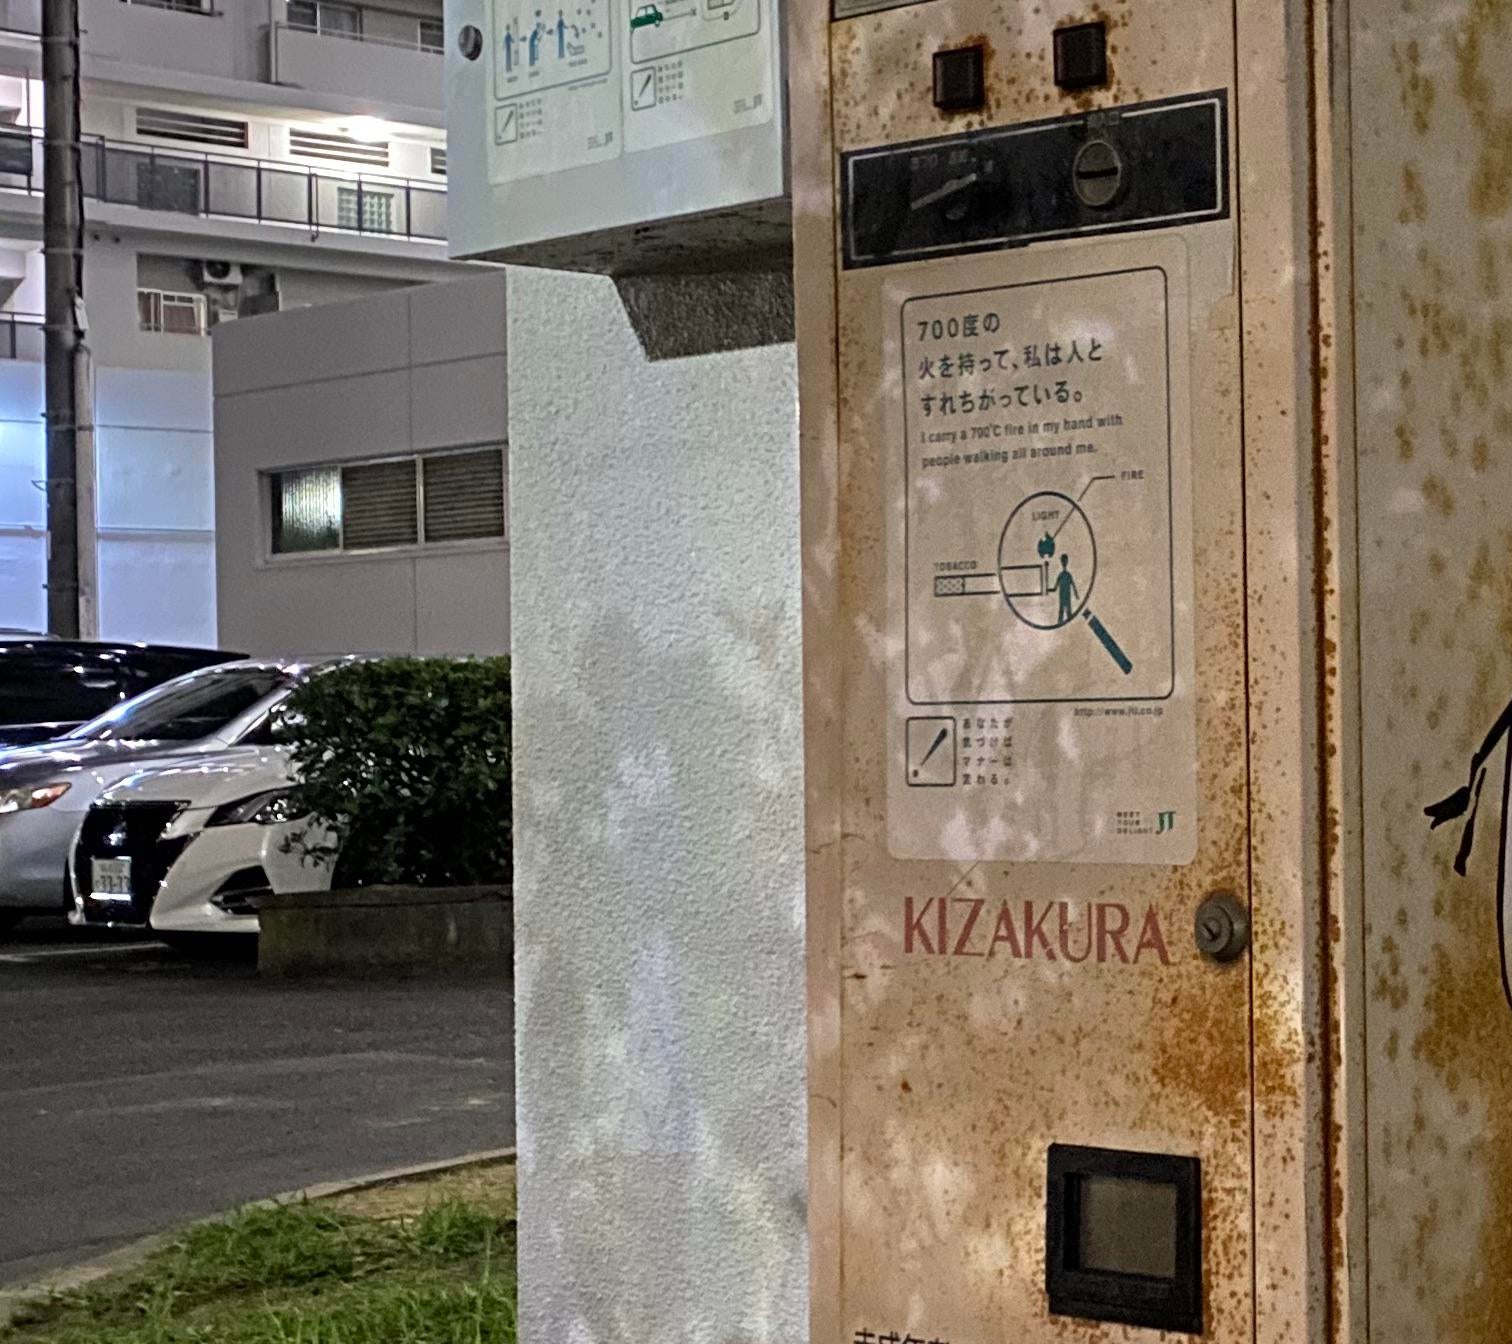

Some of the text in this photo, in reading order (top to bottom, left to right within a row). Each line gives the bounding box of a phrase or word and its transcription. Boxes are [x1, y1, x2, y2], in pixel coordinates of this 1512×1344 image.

[918, 311, 1001, 342] 700度の
[919, 338, 1103, 380] 火を持って、私は人と
[920, 380, 1083, 417] すれちがっている。
[1120, 470, 1144, 481] FIRE
[1031, 510, 1060, 522] LIGHT
[904, 895, 1171, 967] KIZAKURA
